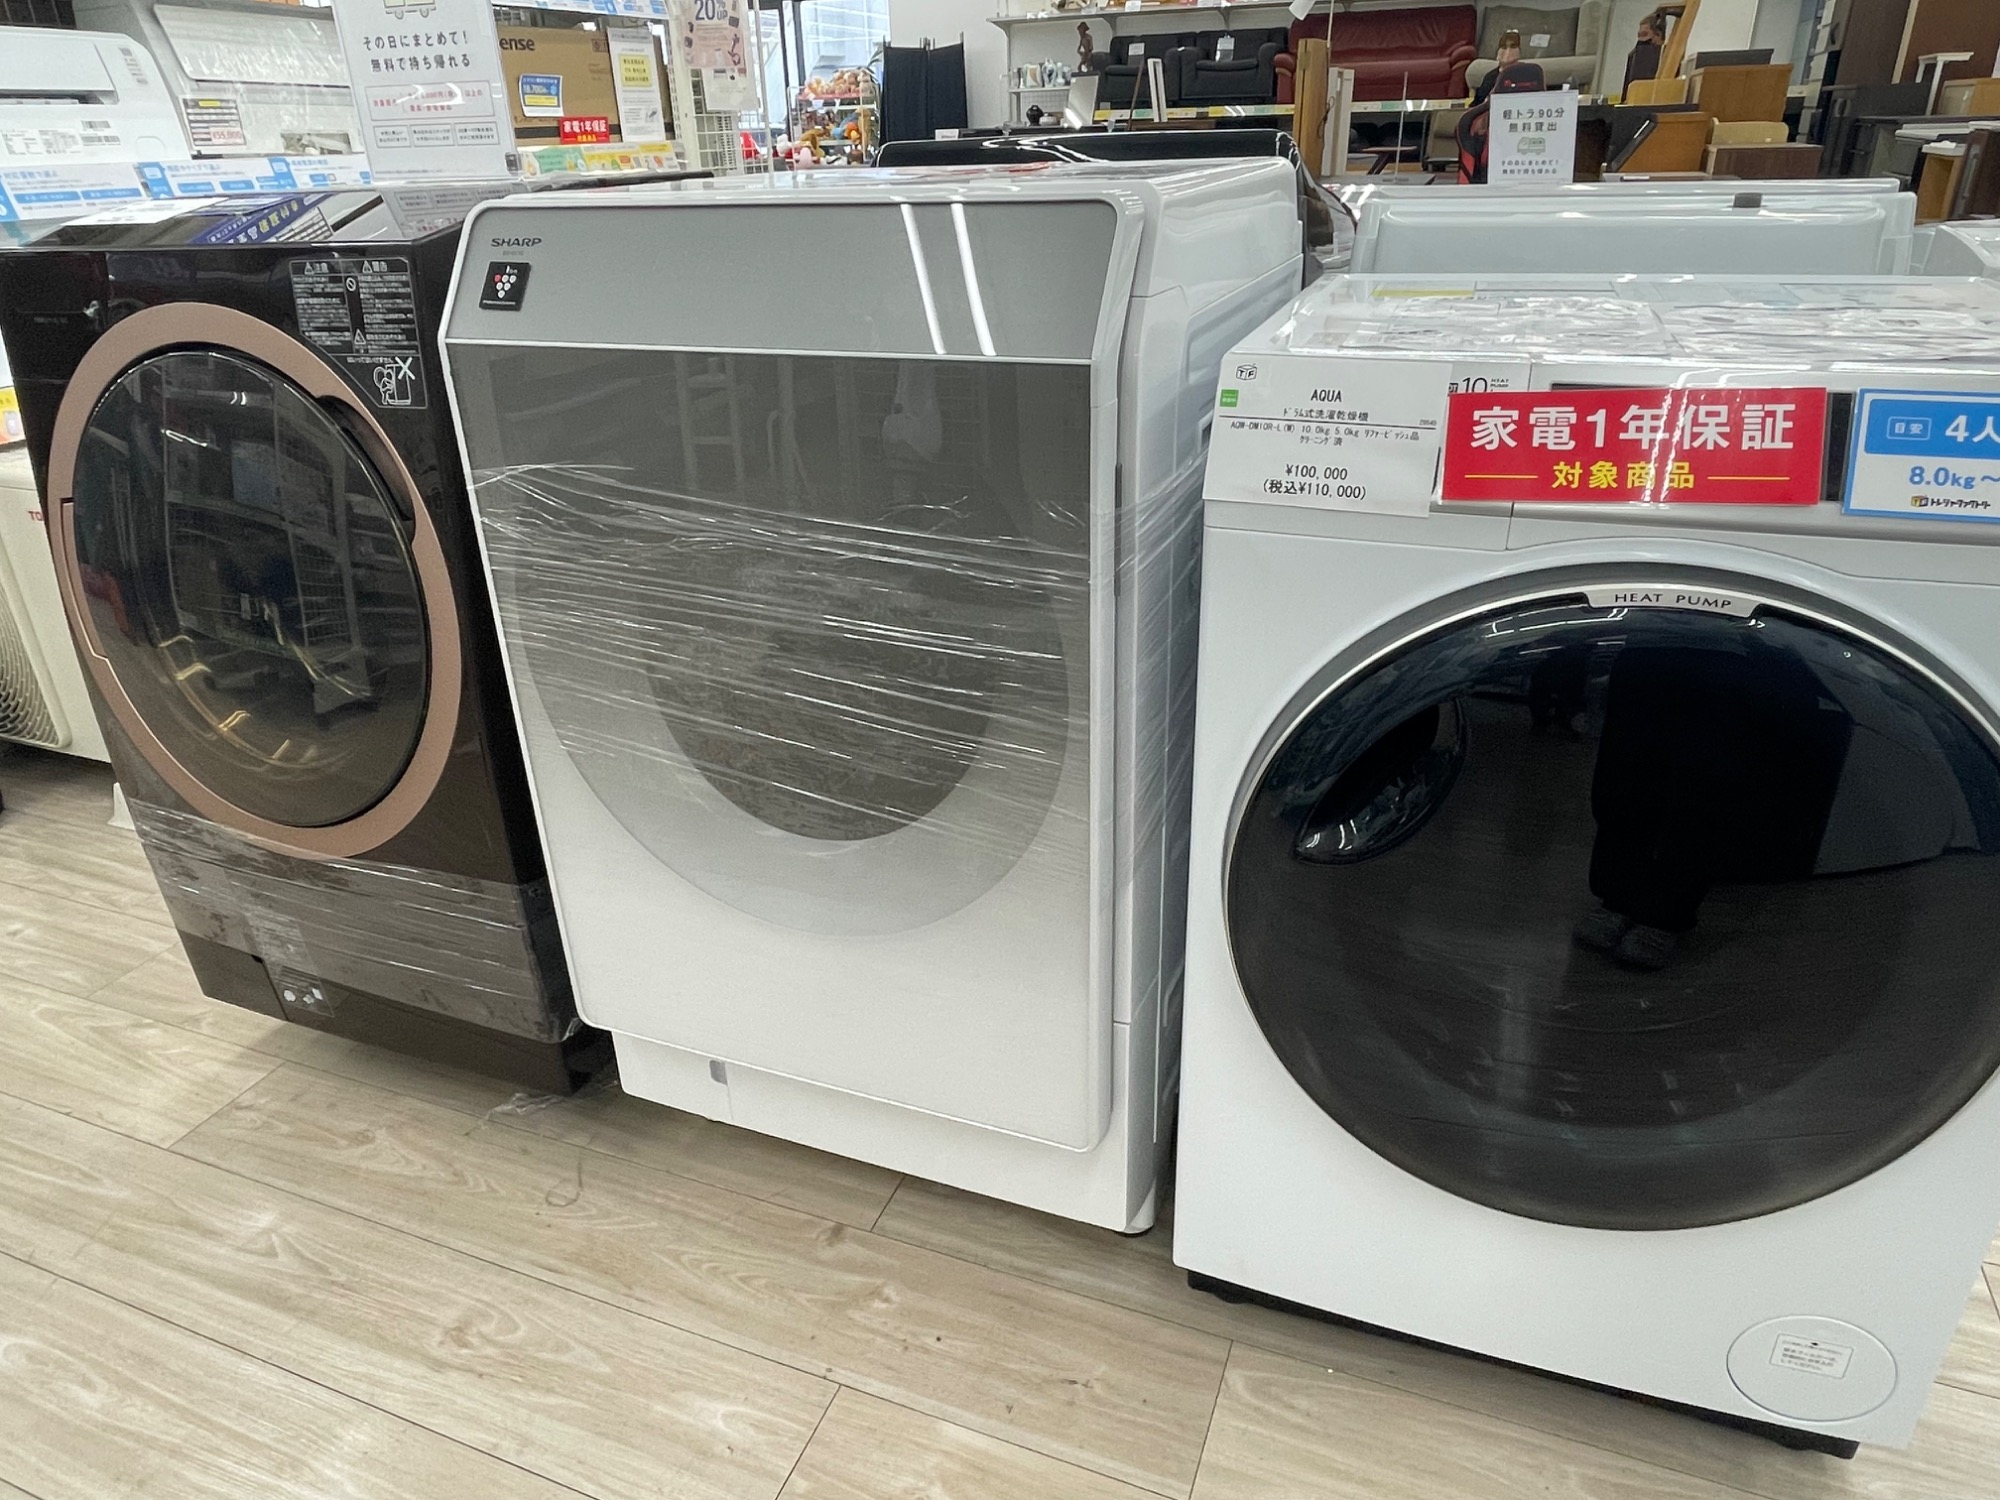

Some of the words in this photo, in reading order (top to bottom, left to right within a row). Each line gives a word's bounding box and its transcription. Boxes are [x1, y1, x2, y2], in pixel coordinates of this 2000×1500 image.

[363, 31, 468, 51] その日にまとめて！
[371, 53, 470, 72] 無料で持ち帰れる
[1503, 107, 1564, 120] 軽トラ90分
[1509, 121, 1557, 133] 無料貸出
[491, 238, 542, 247] SHARP
[1310, 389, 1342, 403] AQUA
[1283, 408, 1368, 422] ドラム式洗濯乾燥機
[1470, 404, 1796, 451] 家電1年保証
[1894, 422, 1923, 435] 目安
[1285, 464, 1348, 480] ¥100,000
[1551, 461, 1695, 489] 対象商品
[1263, 479, 1367, 500] (税込¥110,000)
[1615, 593, 1663, 603] HEAT
[1676, 594, 1732, 608] PUMP
